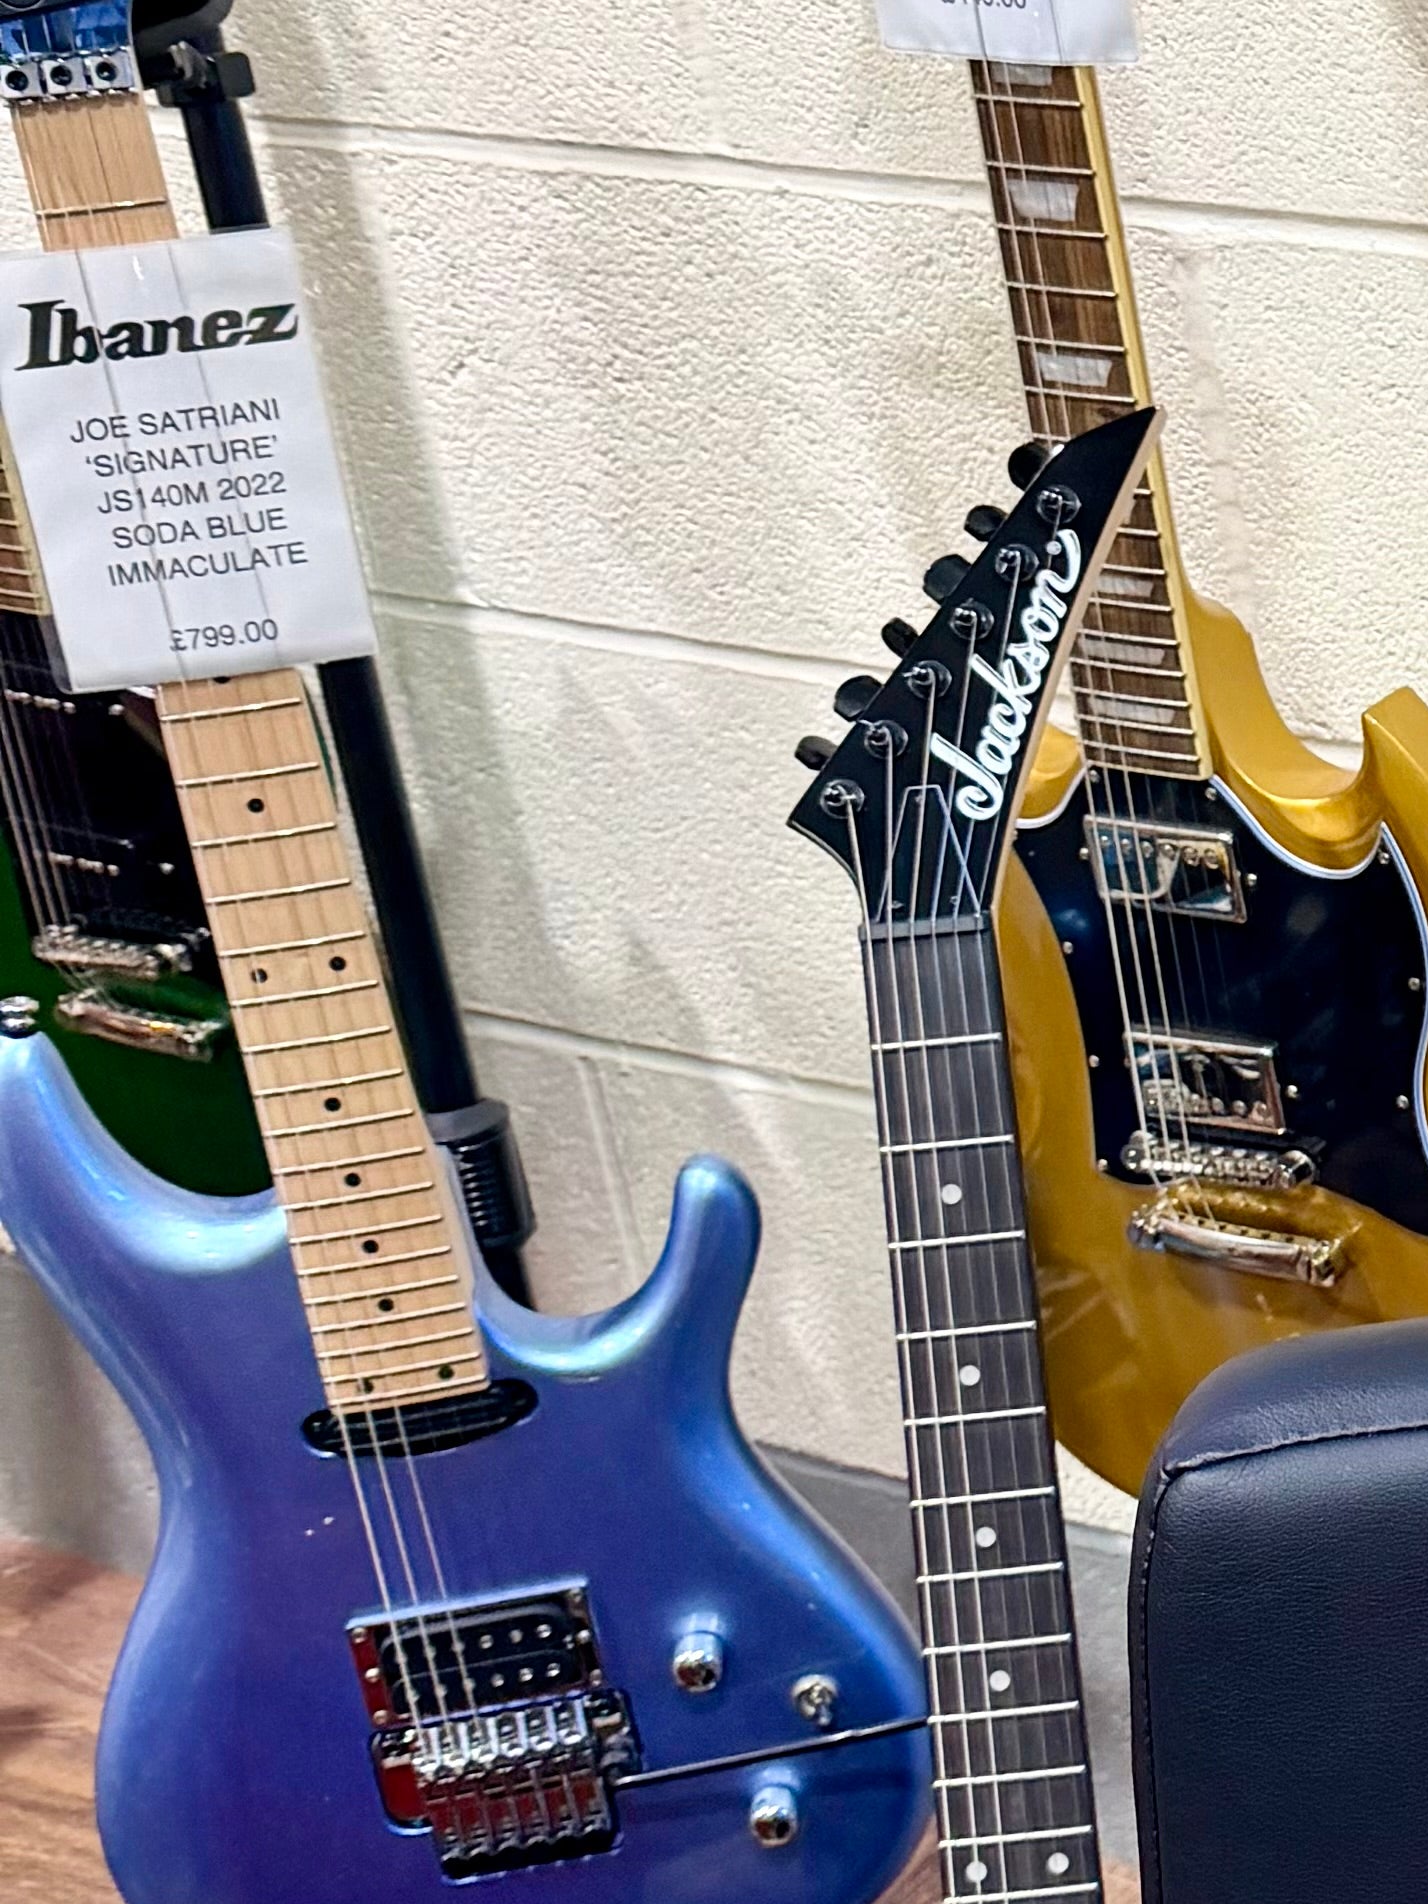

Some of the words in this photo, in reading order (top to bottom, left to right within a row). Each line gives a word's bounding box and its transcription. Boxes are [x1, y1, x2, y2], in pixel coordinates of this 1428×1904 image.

[14, 299, 299, 371] Ibanez
[70, 415, 130, 443] JOE
[139, 398, 281, 436] SATRIANI
[97, 483, 209, 514] JS140M
[216, 472, 287, 500] 2022
[112, 520, 200, 549] SODA
[206, 508, 288, 539] BLUE
[108, 542, 308, 586] IMMACULATE
[170, 618, 279, 652] £799.00
[930, 529, 1081, 821] Jackson
